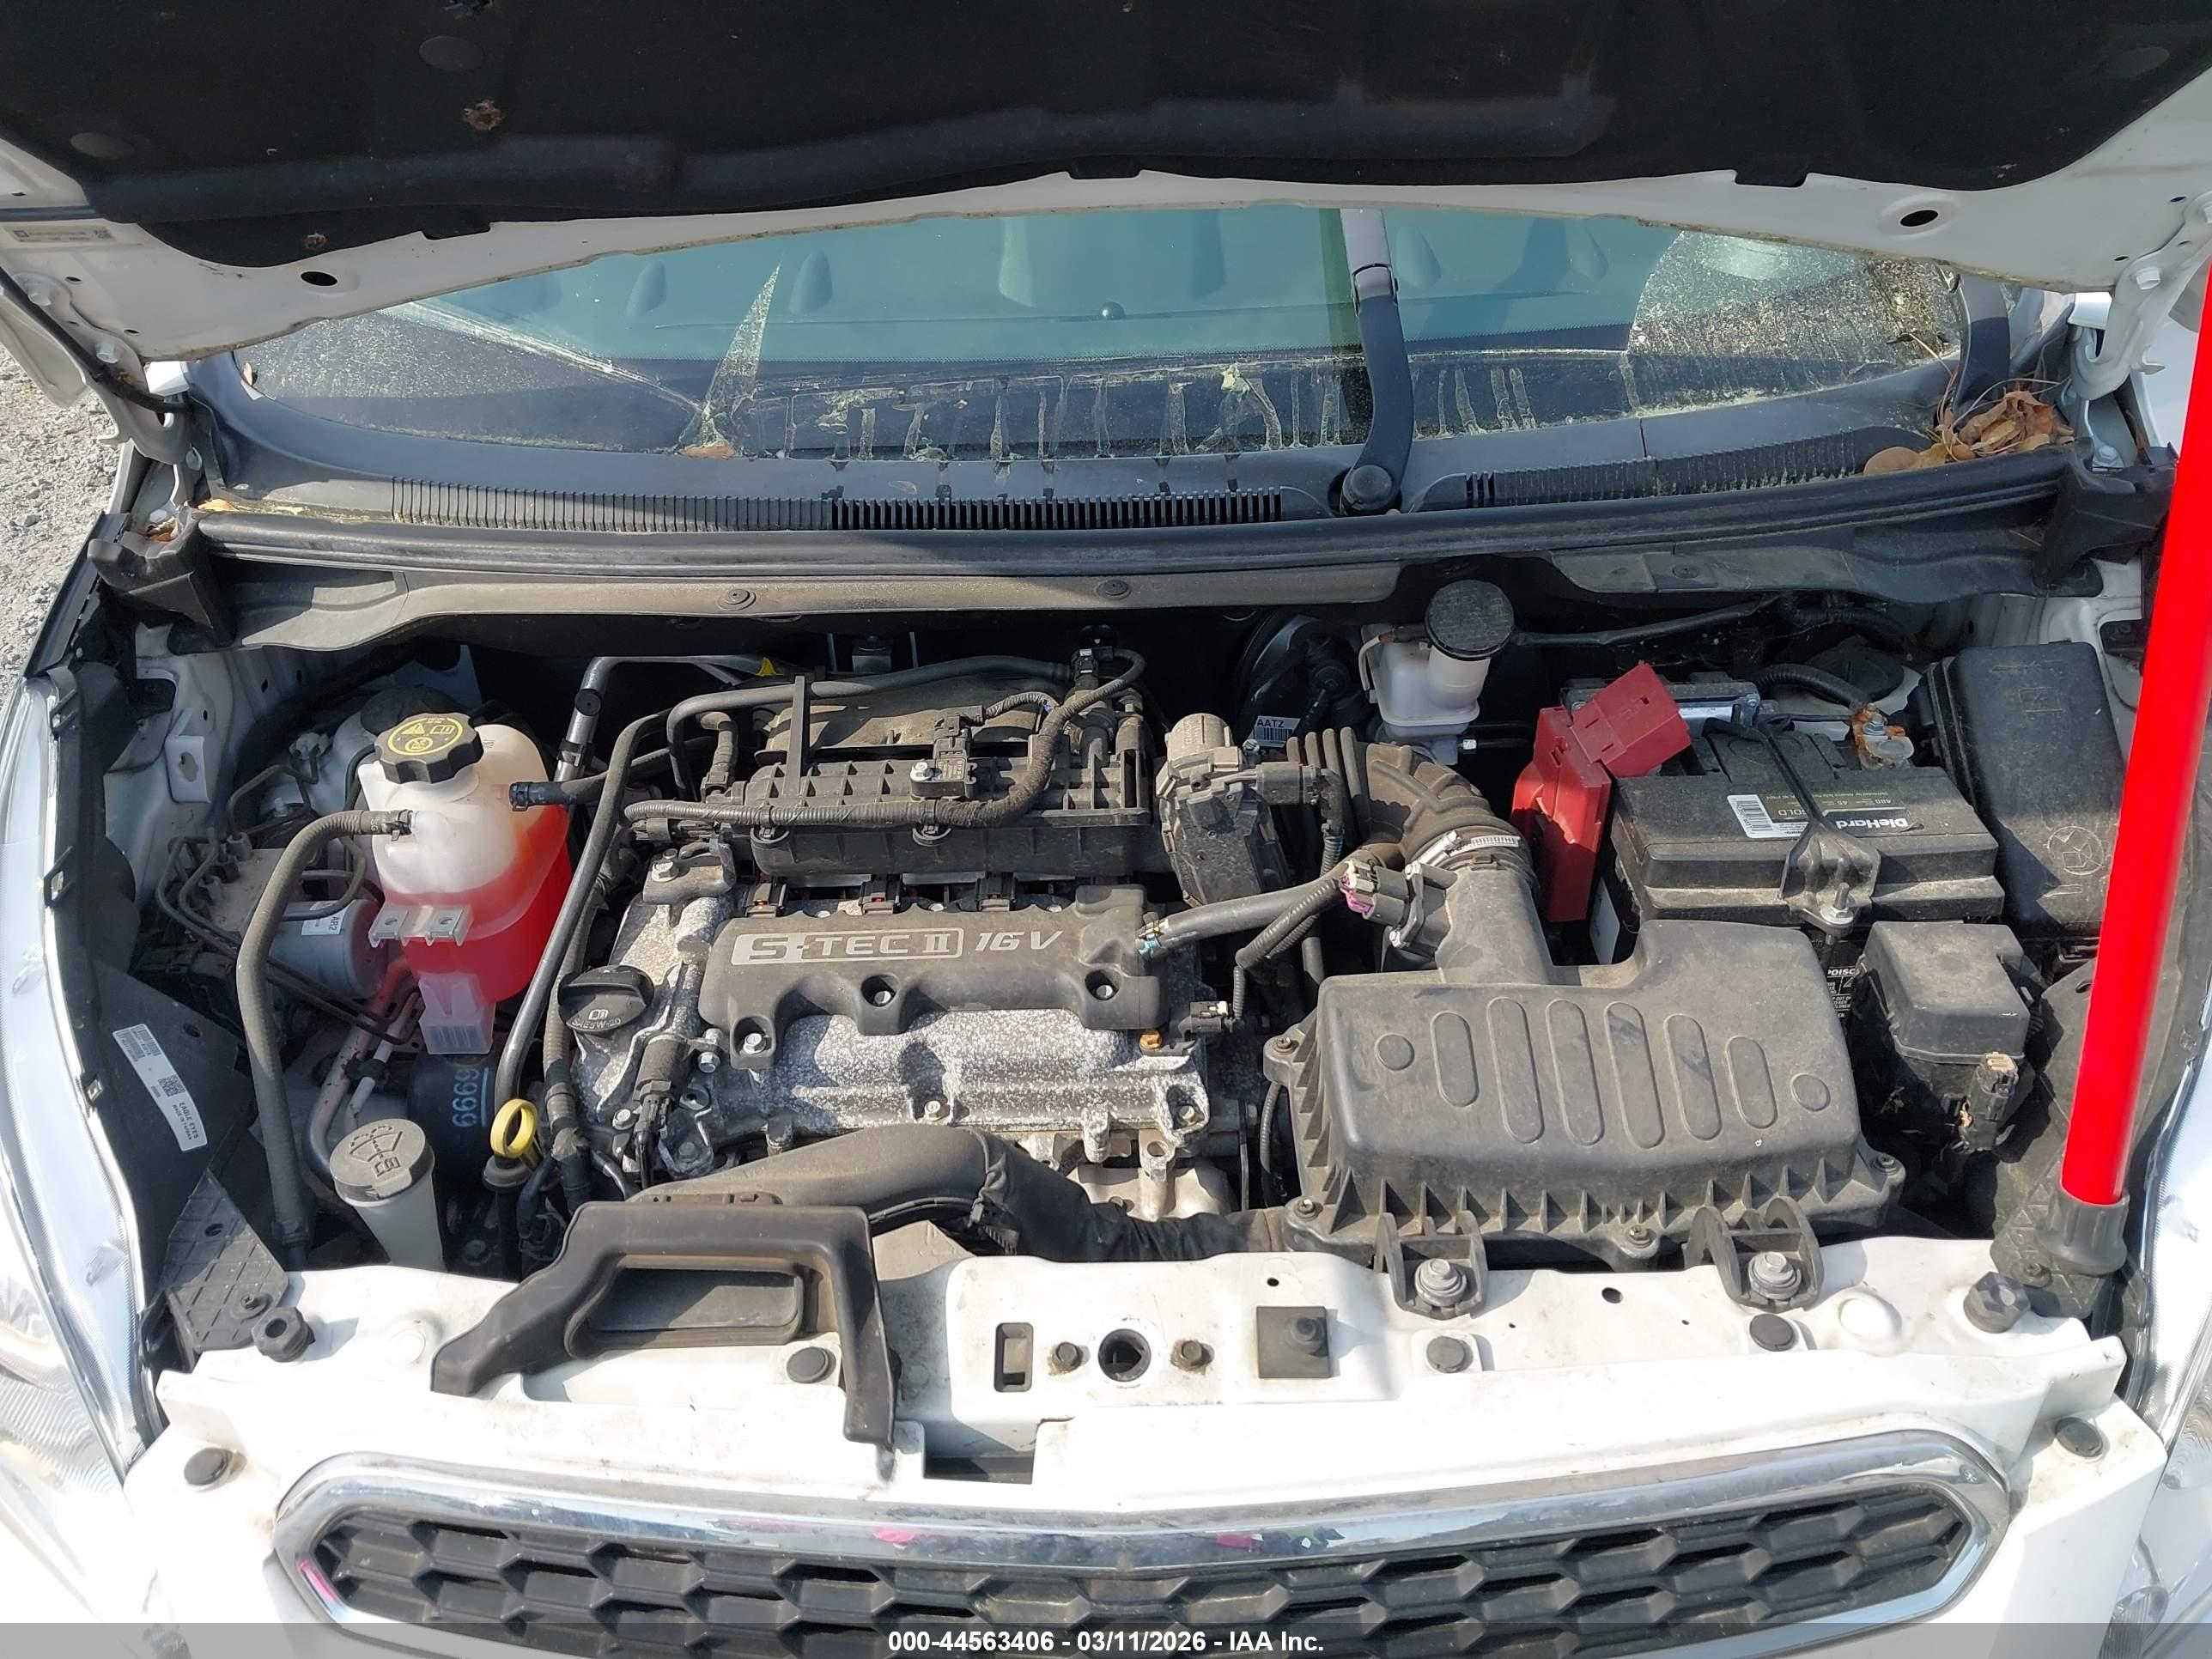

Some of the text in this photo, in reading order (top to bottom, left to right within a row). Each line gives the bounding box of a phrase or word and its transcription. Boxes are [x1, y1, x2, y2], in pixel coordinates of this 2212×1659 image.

[1256, 719, 1285, 728] AATZ
[1835, 817, 1909, 830] DieHard
[921, 933, 951, 954] II
[179, 1102, 199, 1139] EAGLE EYES
